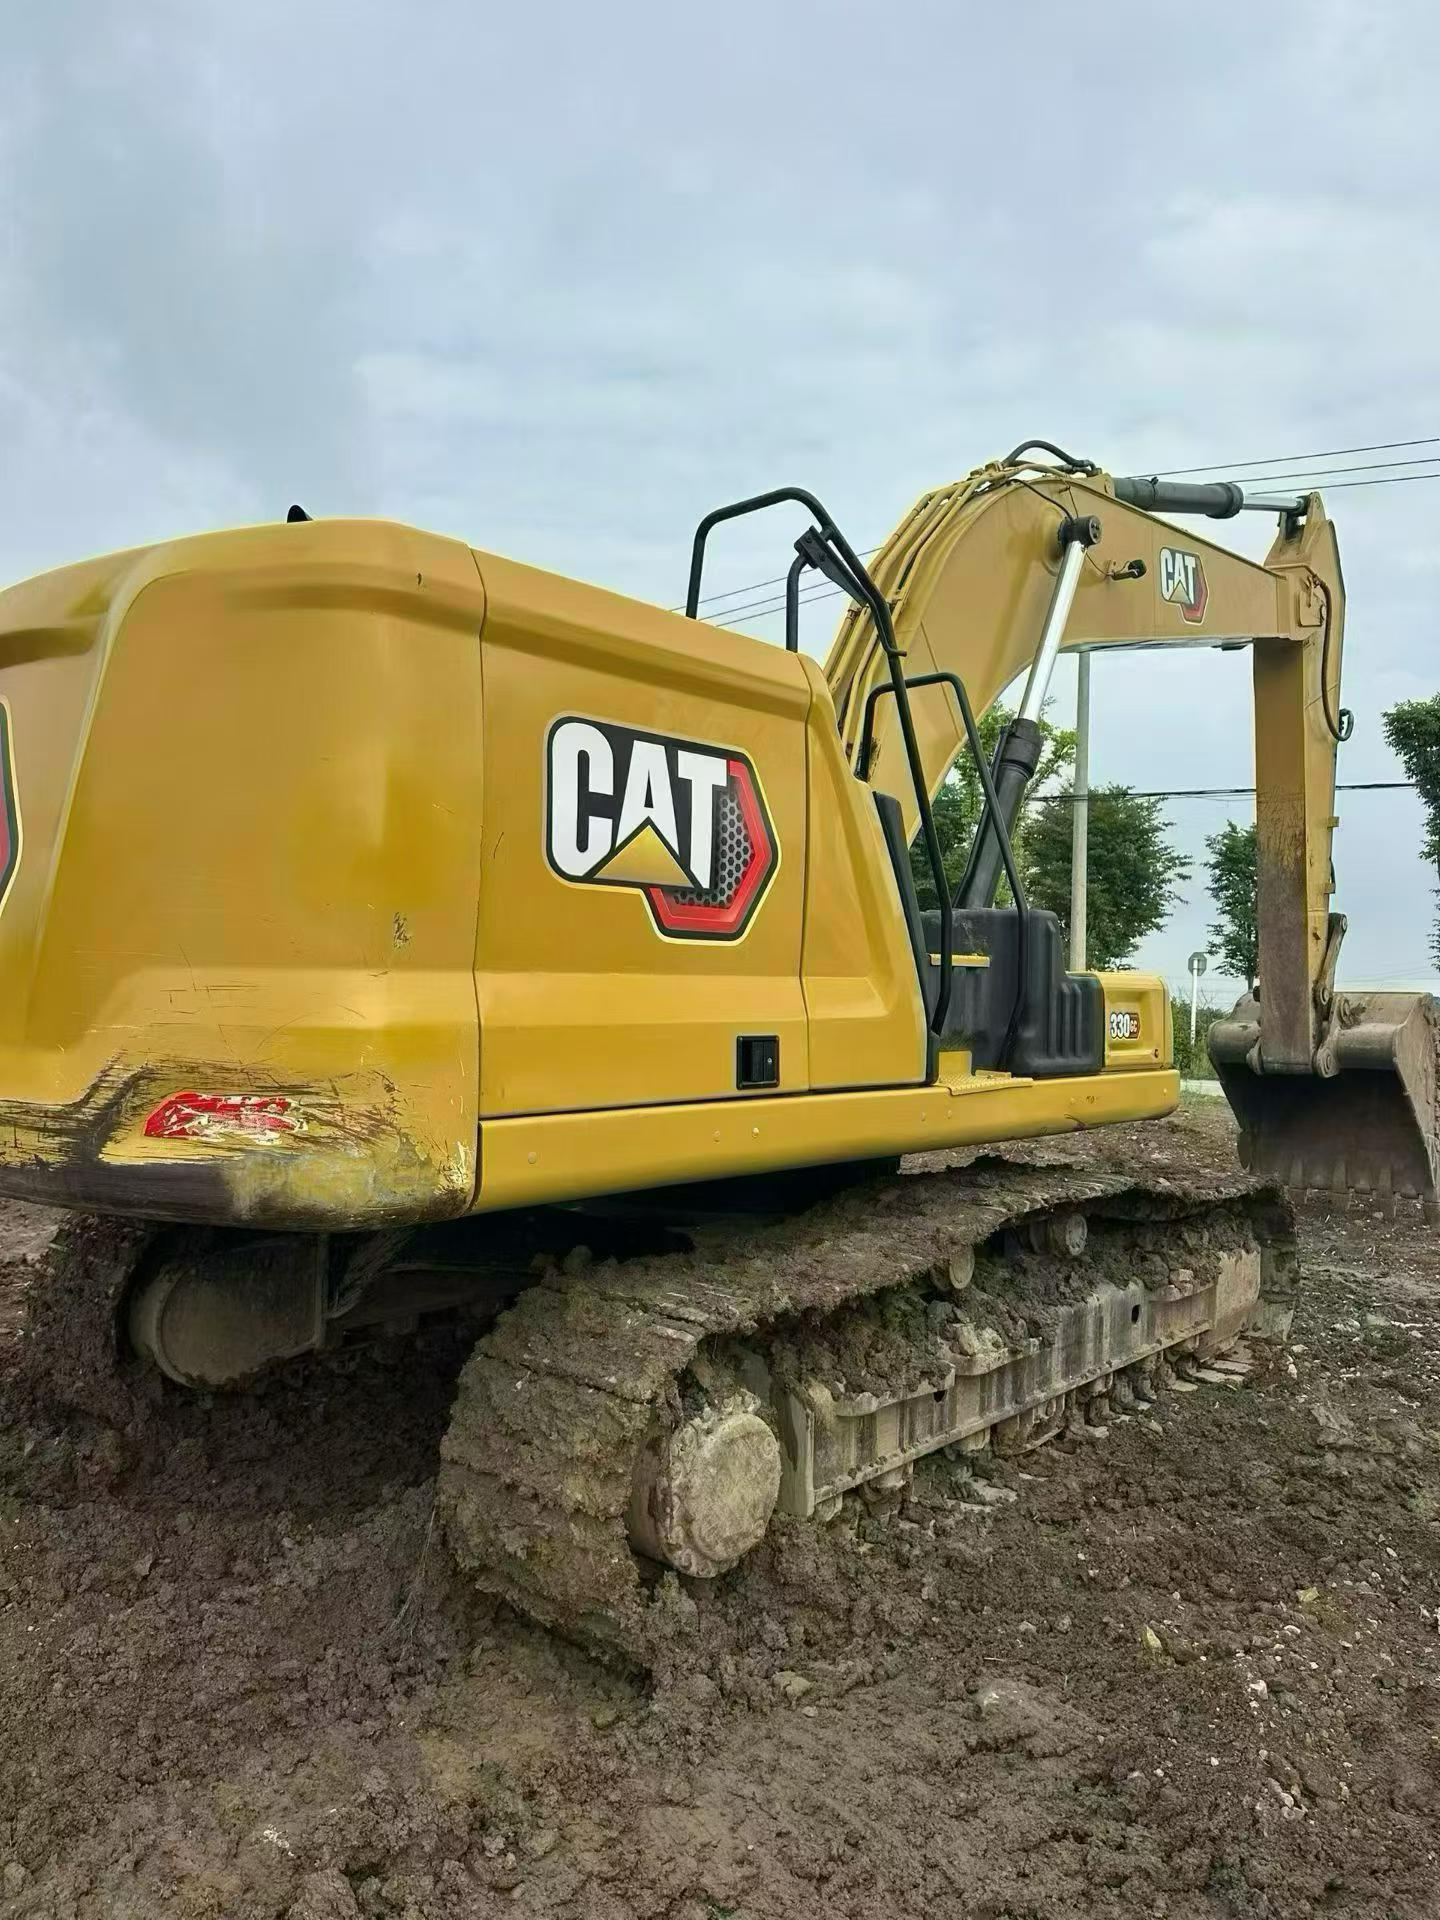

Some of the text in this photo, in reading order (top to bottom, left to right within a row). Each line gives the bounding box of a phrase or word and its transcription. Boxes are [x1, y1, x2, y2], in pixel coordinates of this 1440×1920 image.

[1160, 548, 1196, 604] CAT
[551, 721, 728, 889] CAT
[1110, 1013, 1130, 1038] 330
